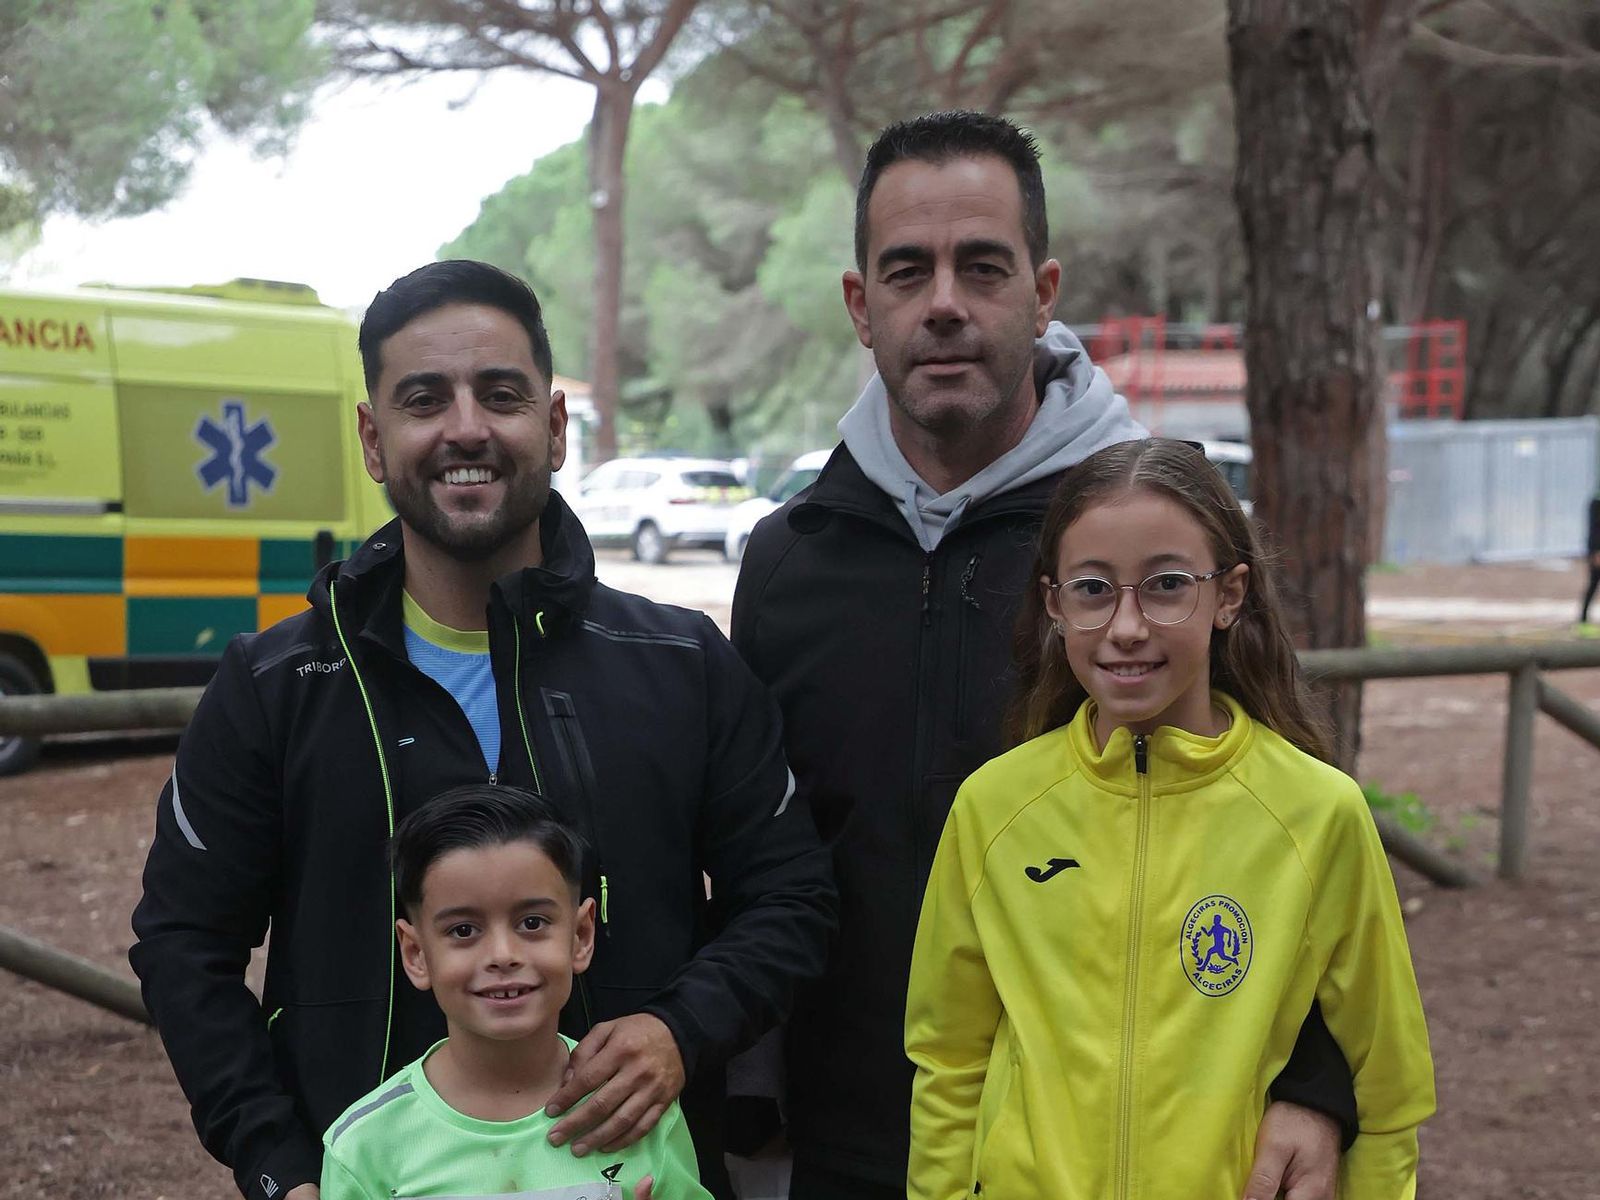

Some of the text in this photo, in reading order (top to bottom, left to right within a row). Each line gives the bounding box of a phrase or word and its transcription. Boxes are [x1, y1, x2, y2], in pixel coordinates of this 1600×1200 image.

[296, 657, 347, 677] TRIBORD
[1185, 900, 1248, 944] ALGECIRAS PROMOCION
[1192, 968, 1242, 990] ALGECIRAS
